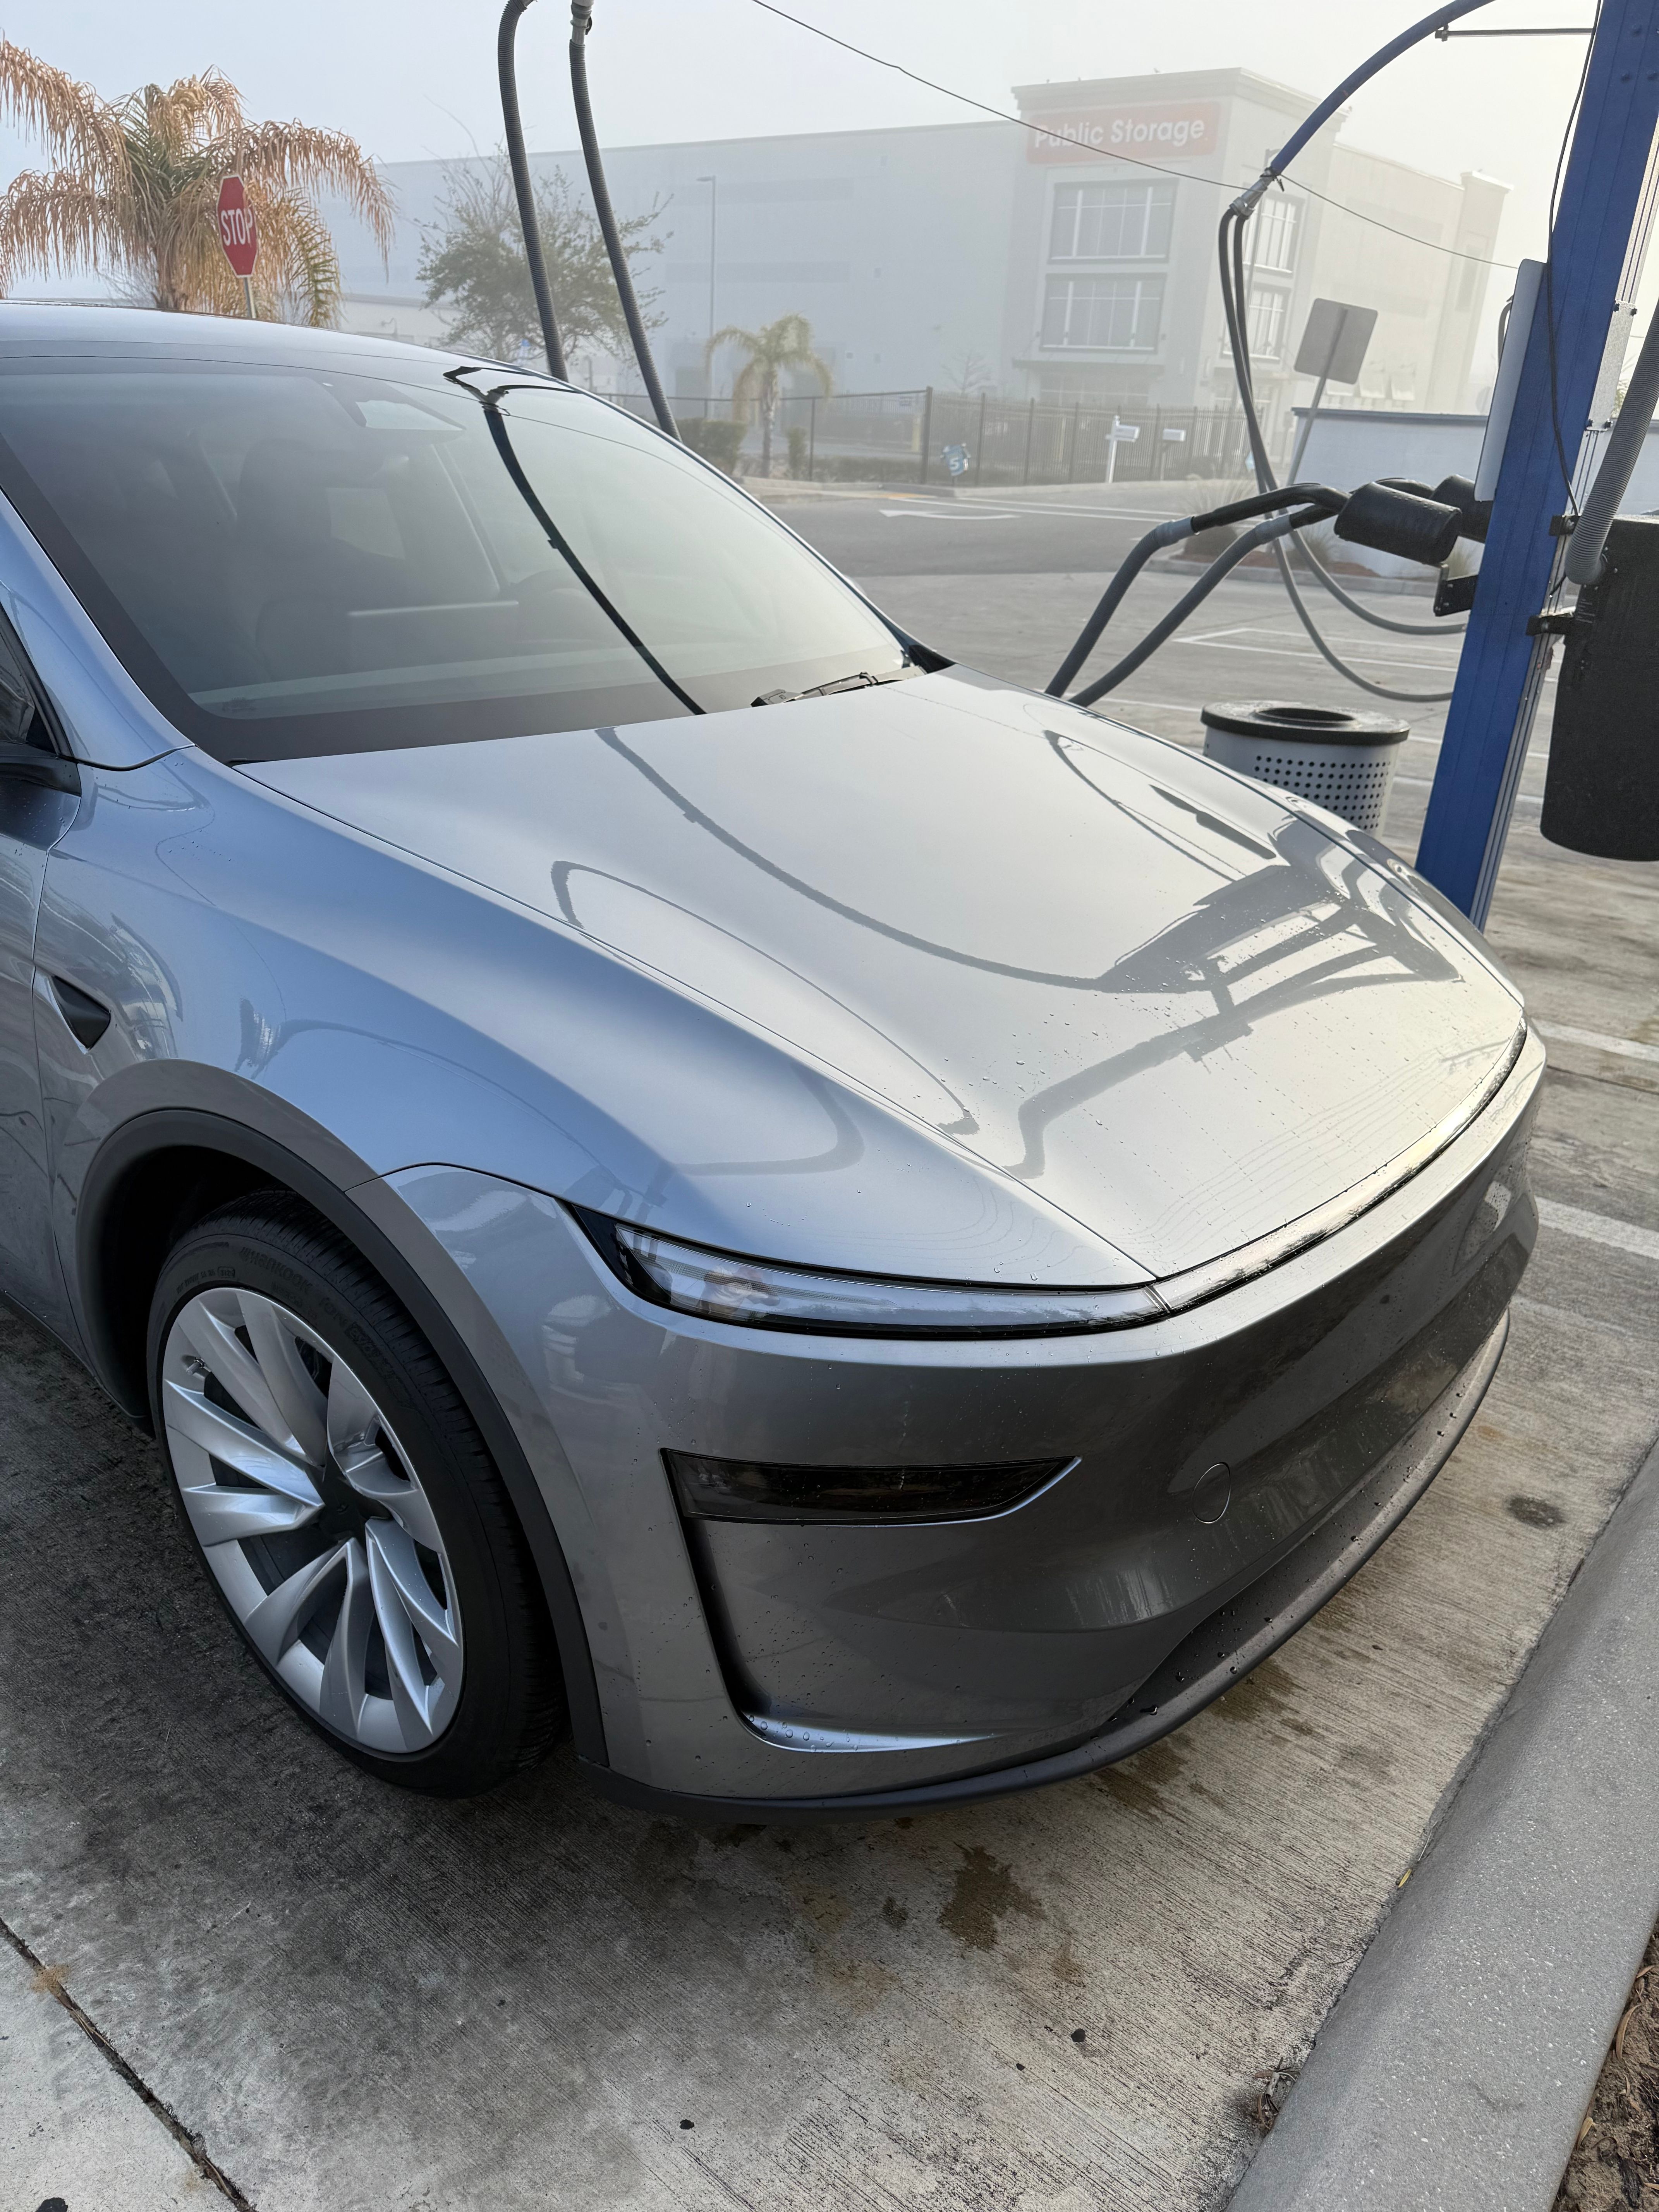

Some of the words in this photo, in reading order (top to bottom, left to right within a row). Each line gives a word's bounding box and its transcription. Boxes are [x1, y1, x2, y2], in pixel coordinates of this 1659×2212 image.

[1034, 121, 1104, 148] Public
[1110, 118, 1205, 147] Storage
[220, 208, 253, 246] STOP
